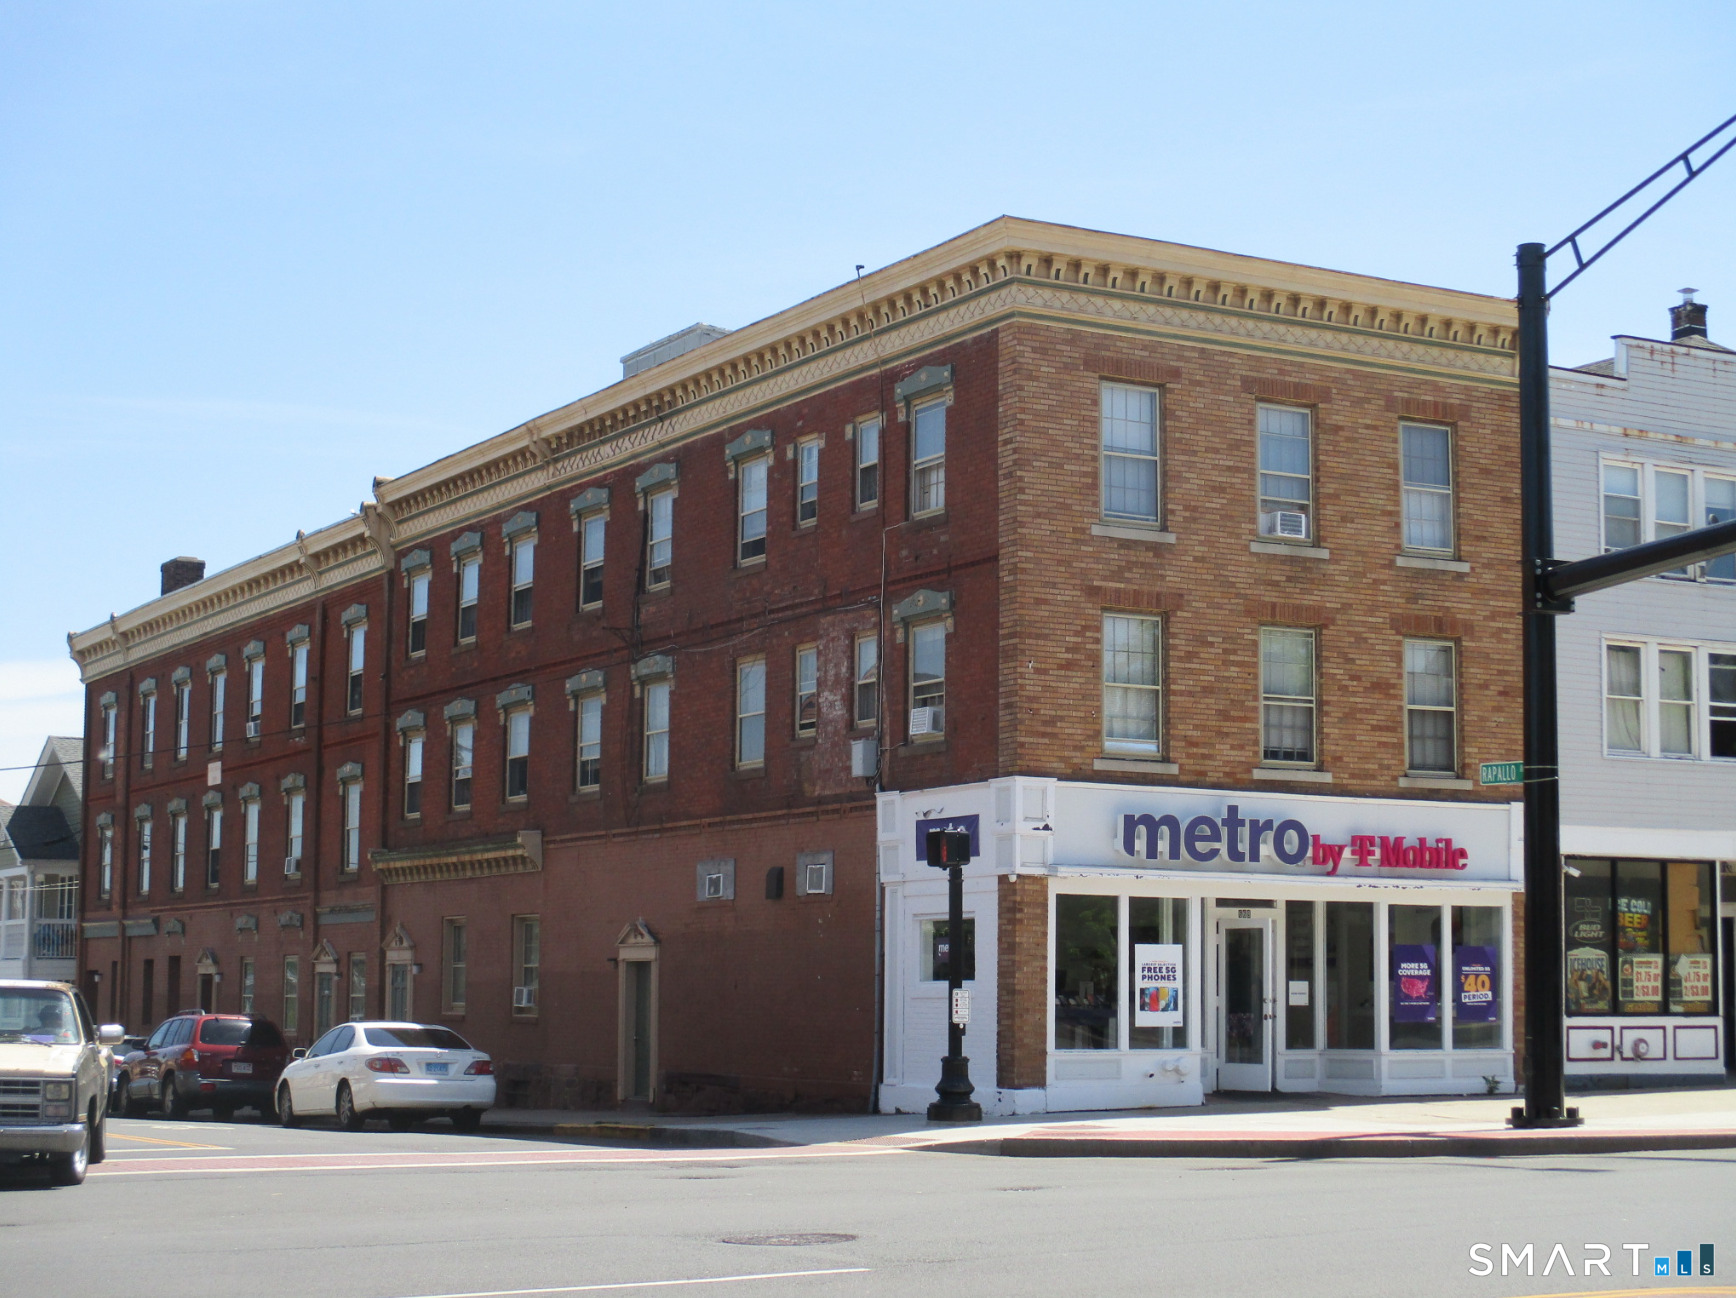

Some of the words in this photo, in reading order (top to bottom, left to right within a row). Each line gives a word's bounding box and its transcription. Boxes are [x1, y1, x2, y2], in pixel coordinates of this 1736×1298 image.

[1482, 765, 1516, 782] RAPALLO
[1122, 804, 1310, 866] metro
[1311, 834, 1348, 876] by
[1574, 930, 1606, 938] LIGHT
[1461, 974, 1491, 992] $40
[1463, 993, 1490, 1001] PERIOD.
